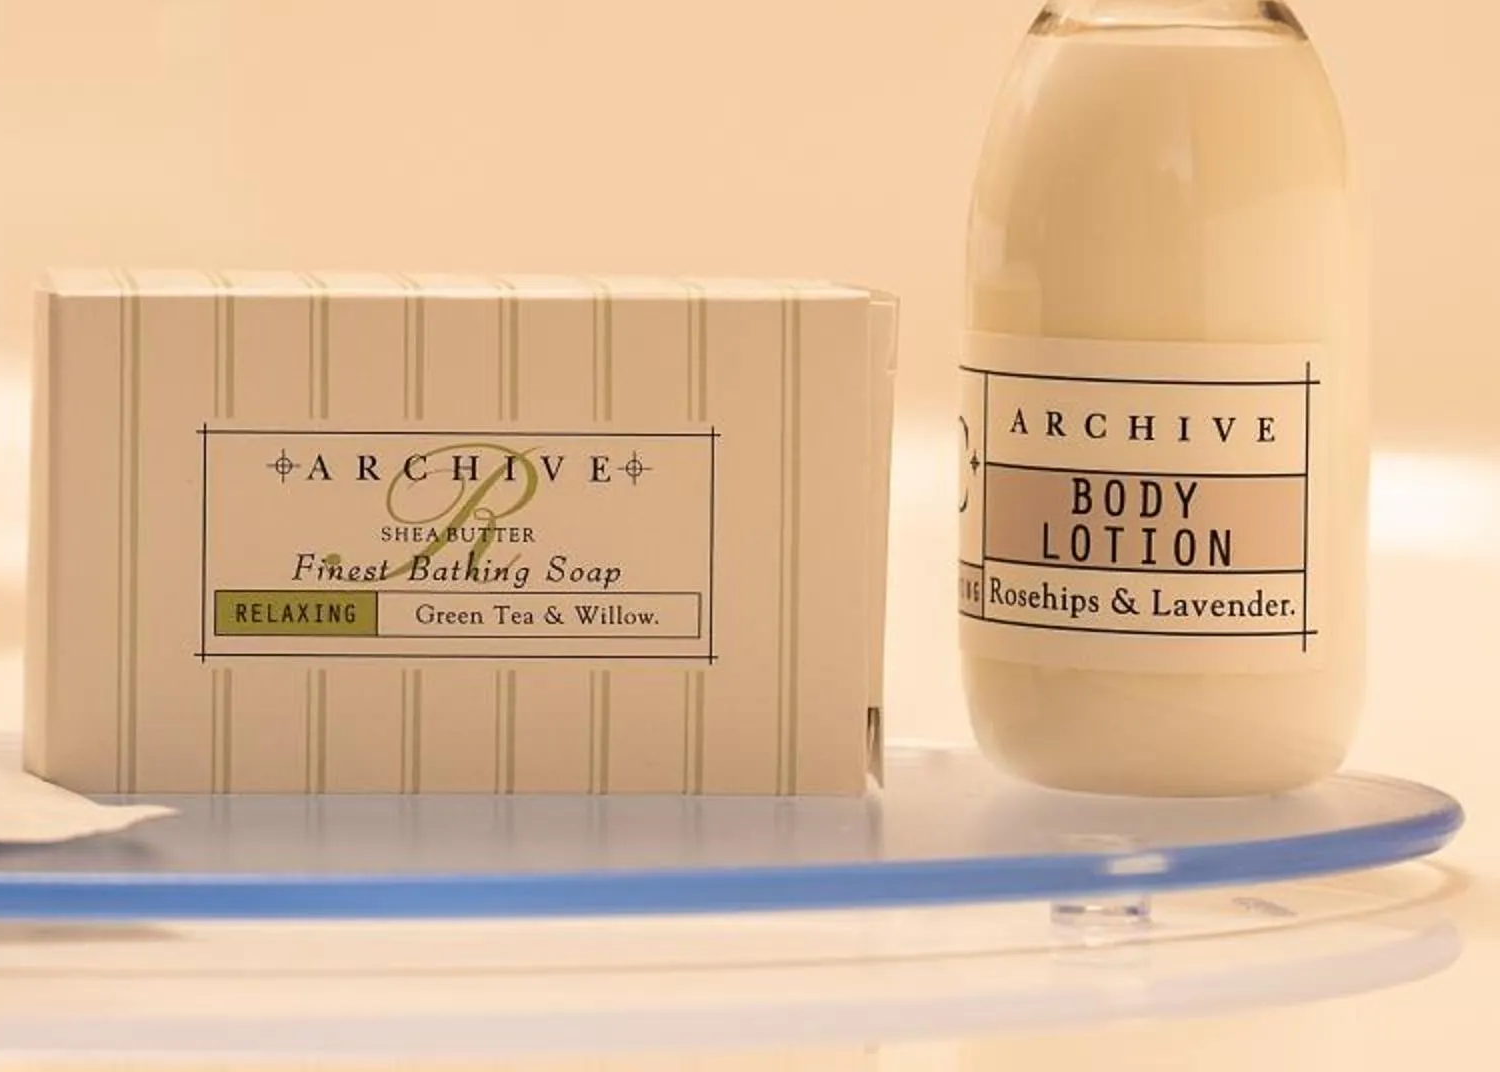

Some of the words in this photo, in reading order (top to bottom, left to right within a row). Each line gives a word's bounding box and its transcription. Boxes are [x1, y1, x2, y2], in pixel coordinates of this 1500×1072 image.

[1008, 406, 1278, 444] ARCHIVE
[306, 452, 612, 484] ARCHIVE
[1071, 477, 1198, 519] BODY
[381, 527, 438, 543] SHEA
[447, 527, 536, 543] BUTTER
[1042, 522, 1232, 567] LOTION
[292, 553, 388, 582] Finest
[409, 553, 530, 589] Bathing
[547, 556, 622, 589] Soap
[235, 604, 357, 623] RELAXING
[416, 605, 484, 625] Green
[493, 605, 534, 625] Tea
[545, 605, 565, 625] &
[575, 605, 660, 625] Willow.
[989, 577, 1100, 618] Rosehips
[1111, 587, 1140, 615] &
[1153, 589, 1296, 618] Lavender.
